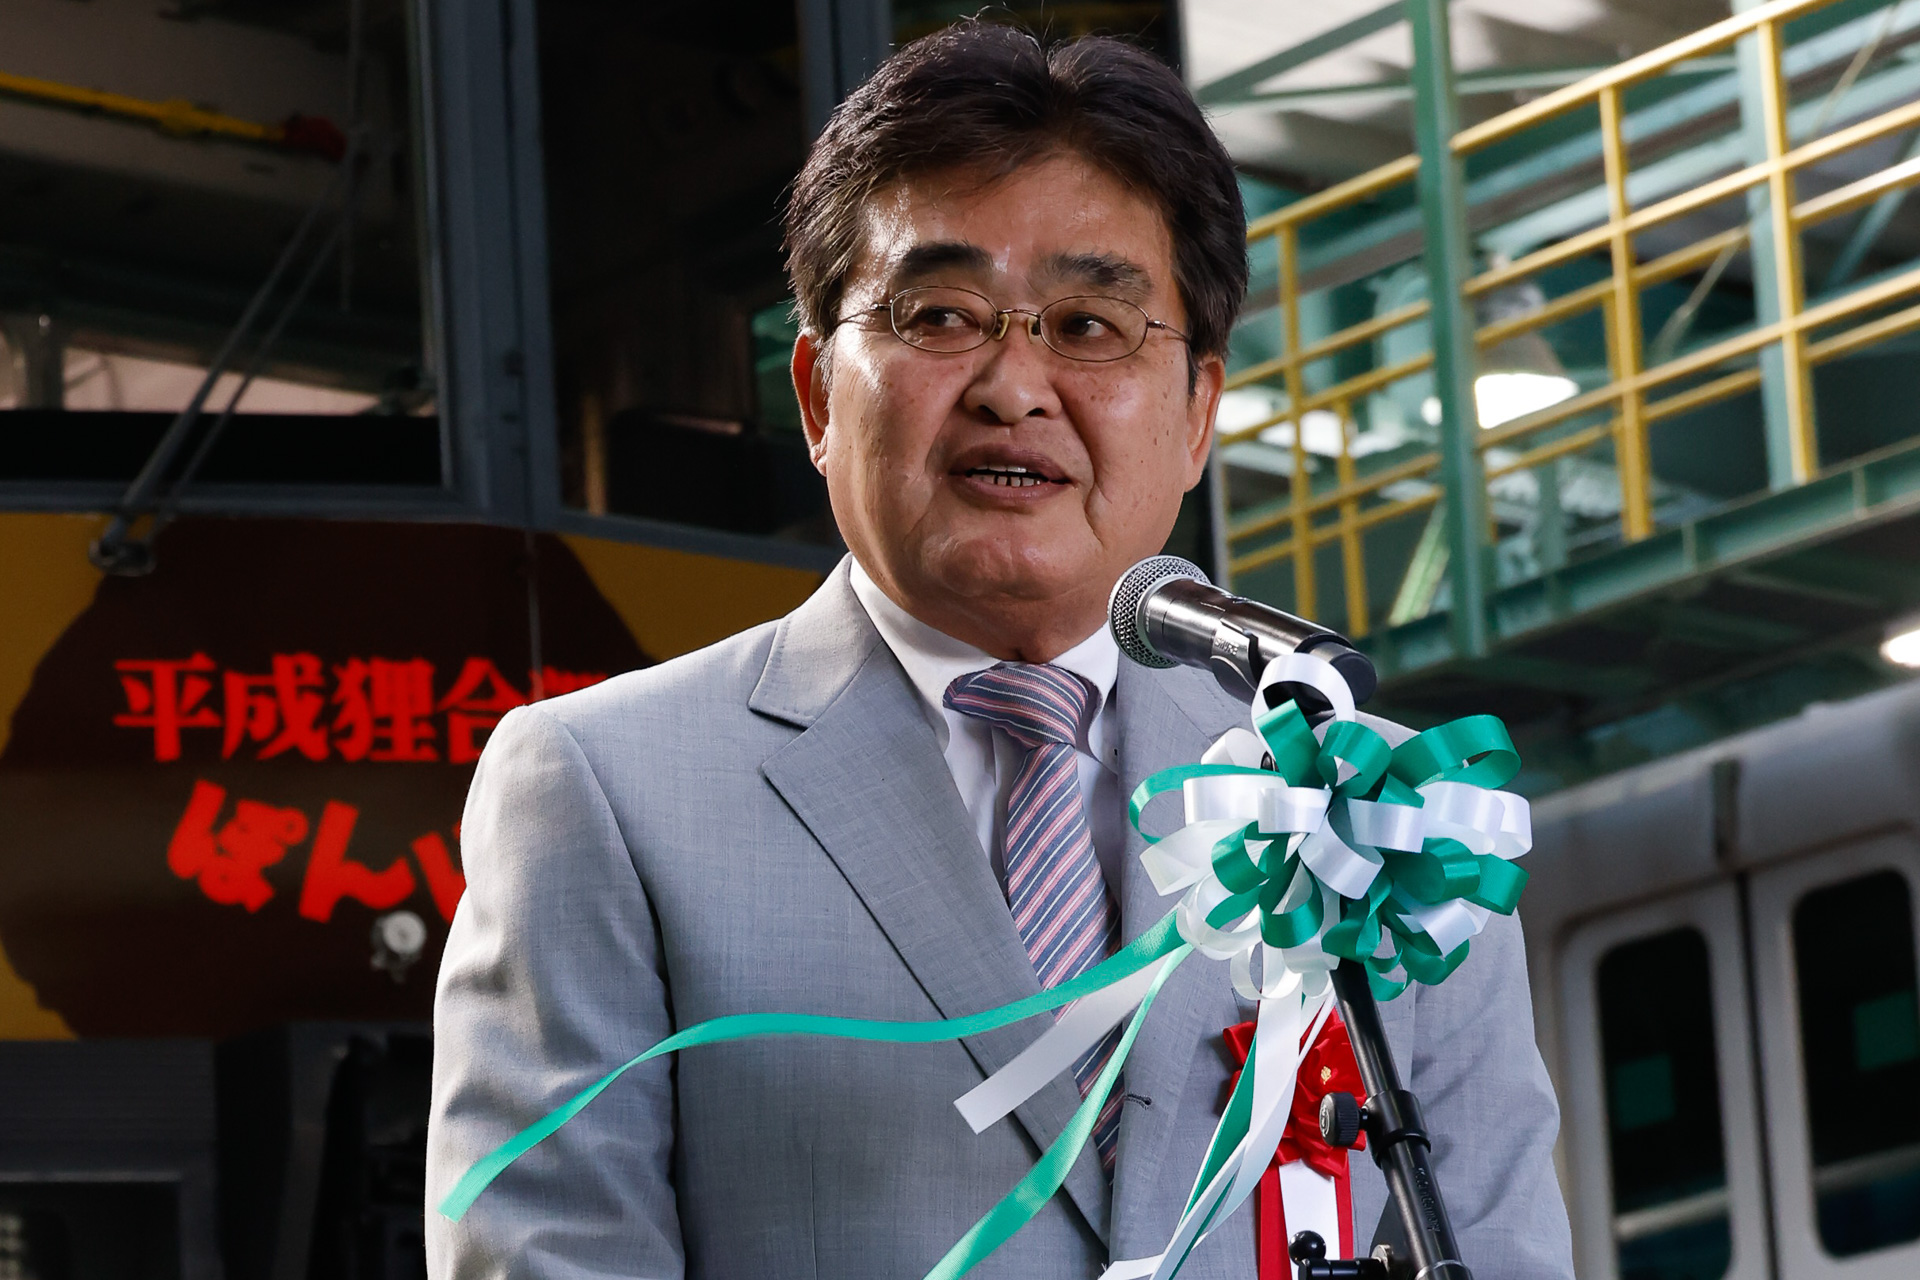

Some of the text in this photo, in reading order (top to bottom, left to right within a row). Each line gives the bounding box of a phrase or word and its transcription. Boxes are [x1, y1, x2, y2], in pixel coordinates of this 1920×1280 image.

[112, 652, 608, 763] 平成狸合
[167, 779, 467, 924] ぽん
